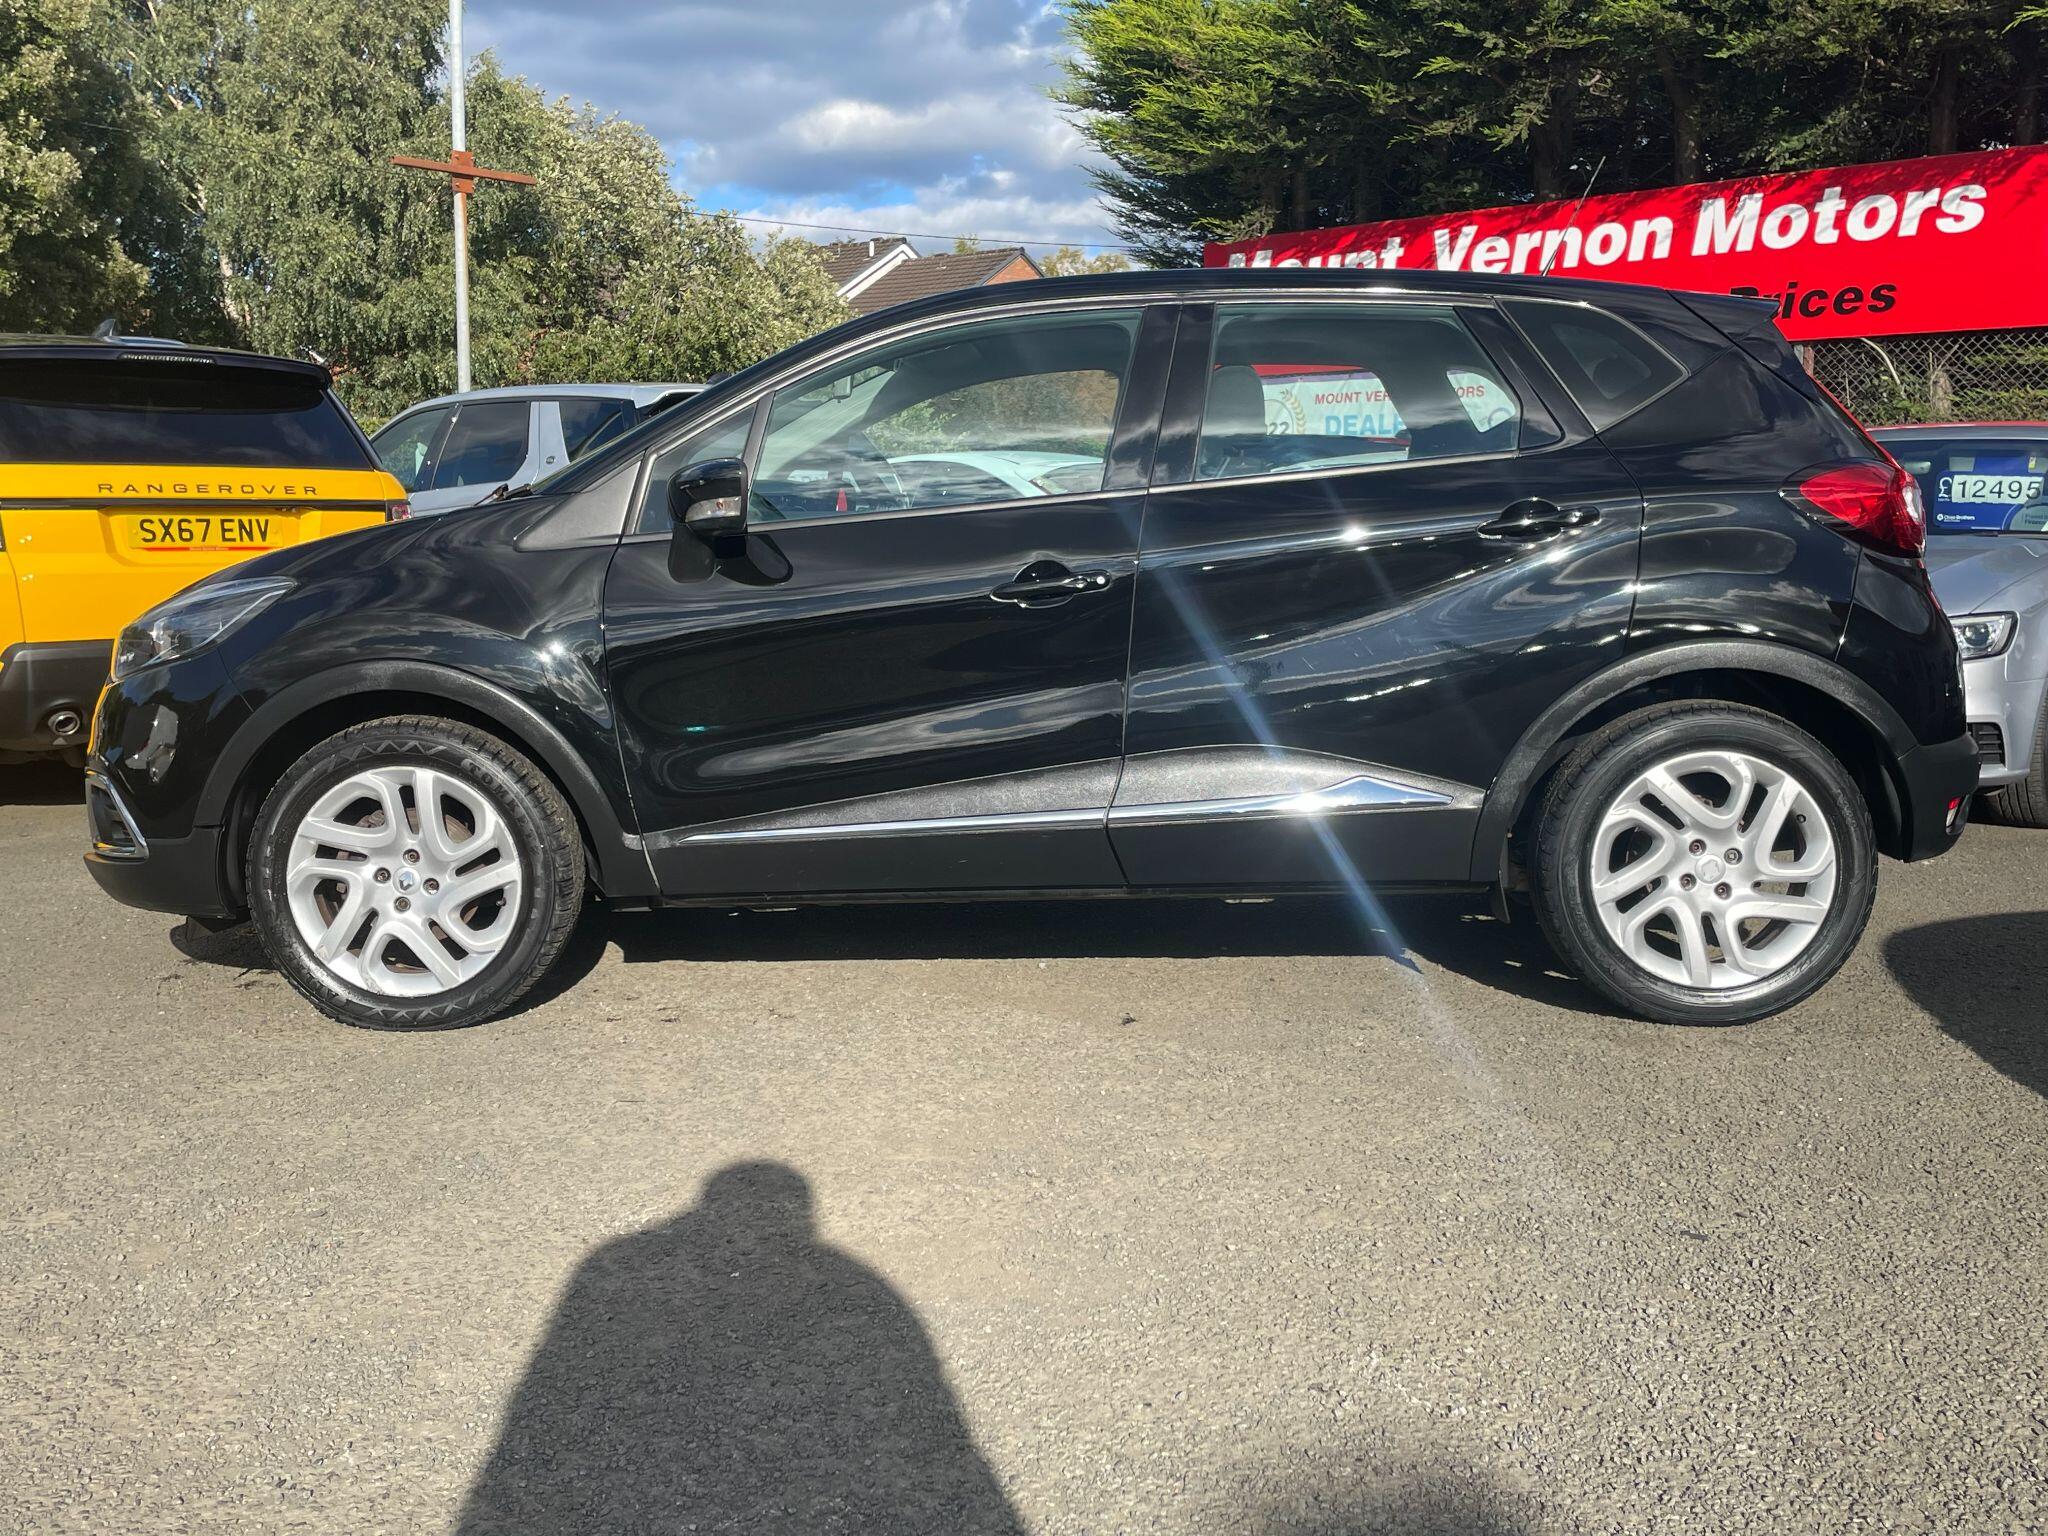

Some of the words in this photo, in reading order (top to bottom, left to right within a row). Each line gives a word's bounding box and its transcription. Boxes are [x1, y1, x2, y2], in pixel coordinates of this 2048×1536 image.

[1434, 215, 1675, 274] Vernon
[1691, 183, 1987, 257] Motors
[1730, 281, 1897, 320] ices
[1314, 391, 1362, 405] MOUNT
[139, 518, 212, 543] SX67
[220, 518, 270, 543] ENV
